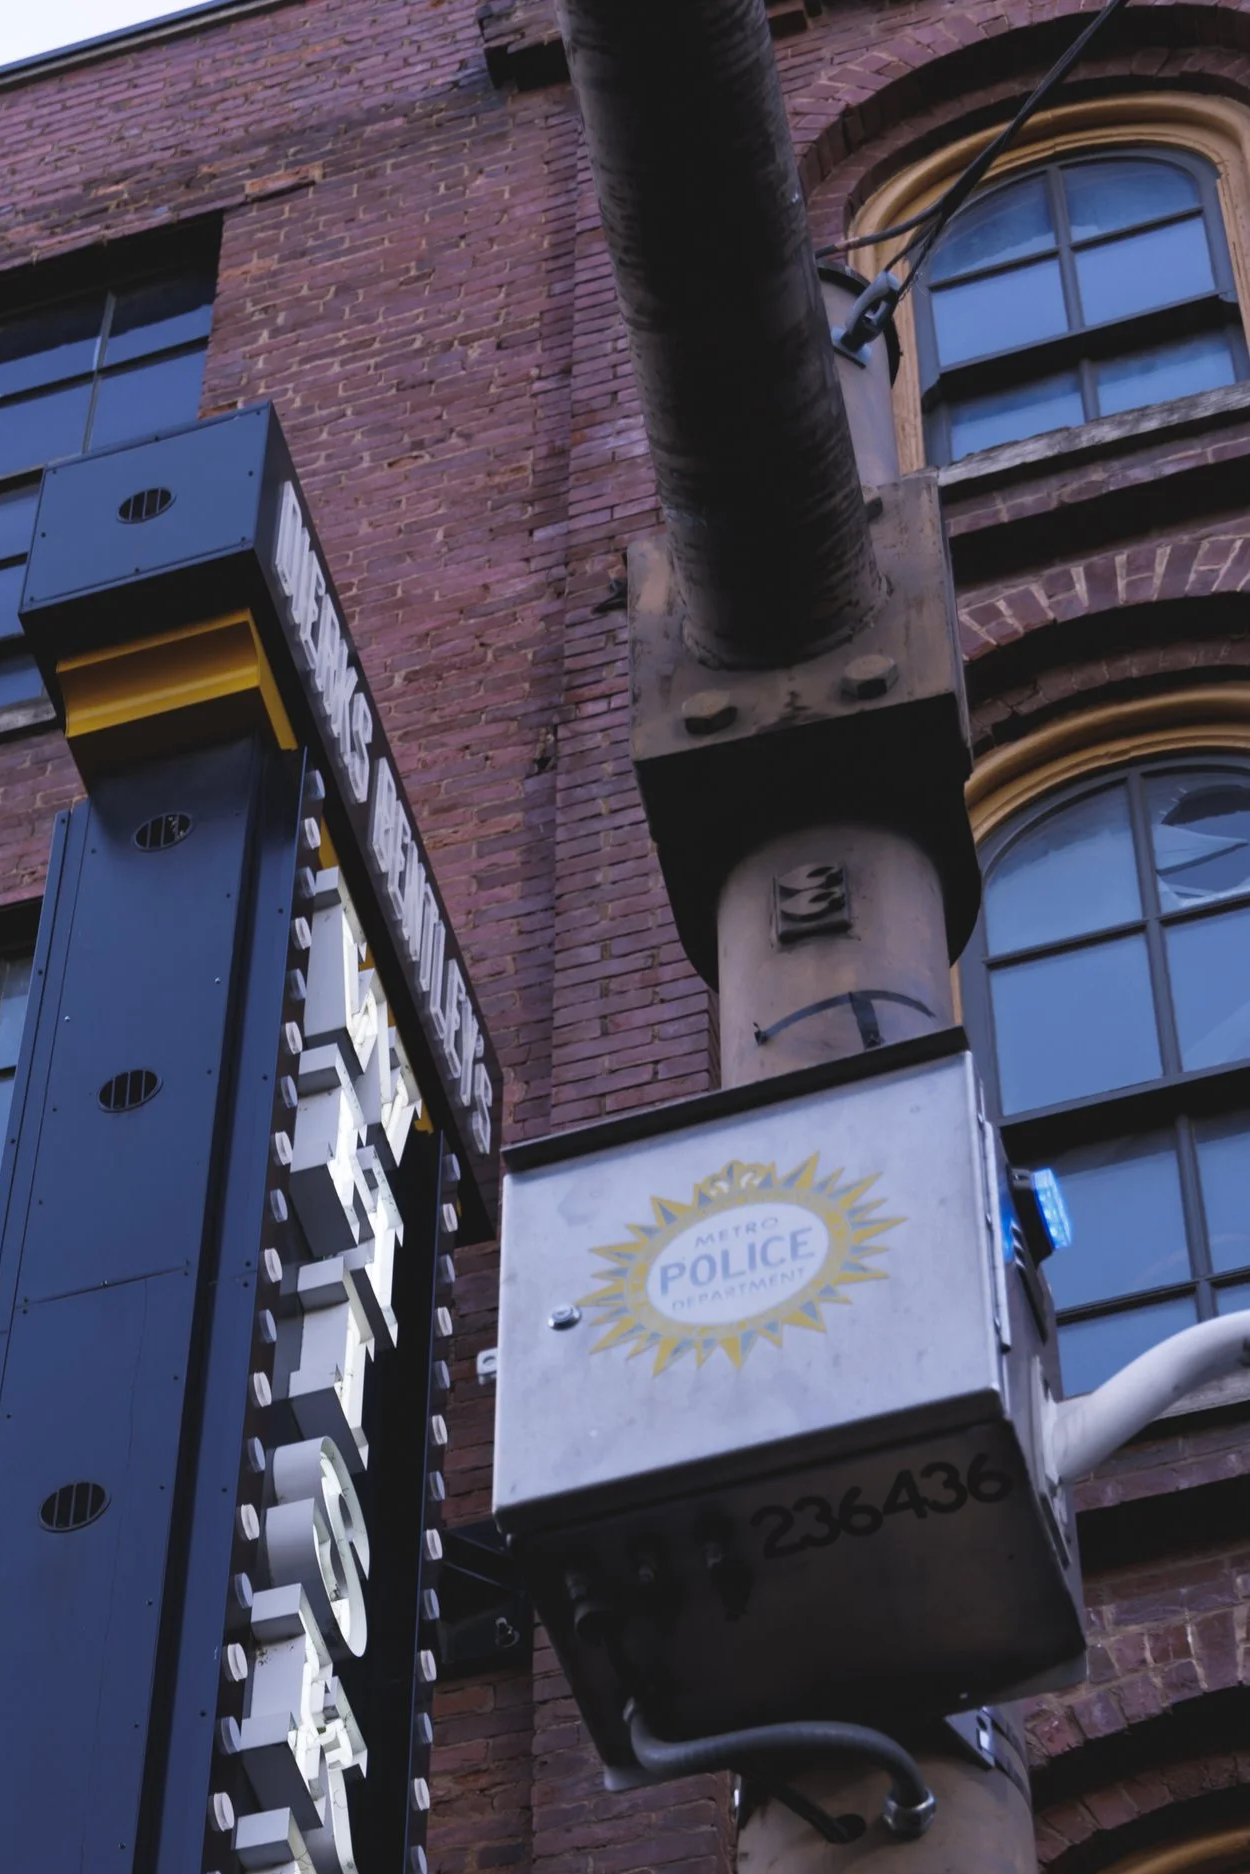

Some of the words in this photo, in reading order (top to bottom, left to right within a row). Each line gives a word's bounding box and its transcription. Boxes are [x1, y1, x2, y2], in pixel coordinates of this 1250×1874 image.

[274, 479, 374, 803] DIERKS
[659, 1225, 816, 1298] POLICE
[694, 1216, 780, 1250] METRO
[671, 1267, 806, 1314] DEPARTMENT
[750, 1452, 1014, 1560] 236436
